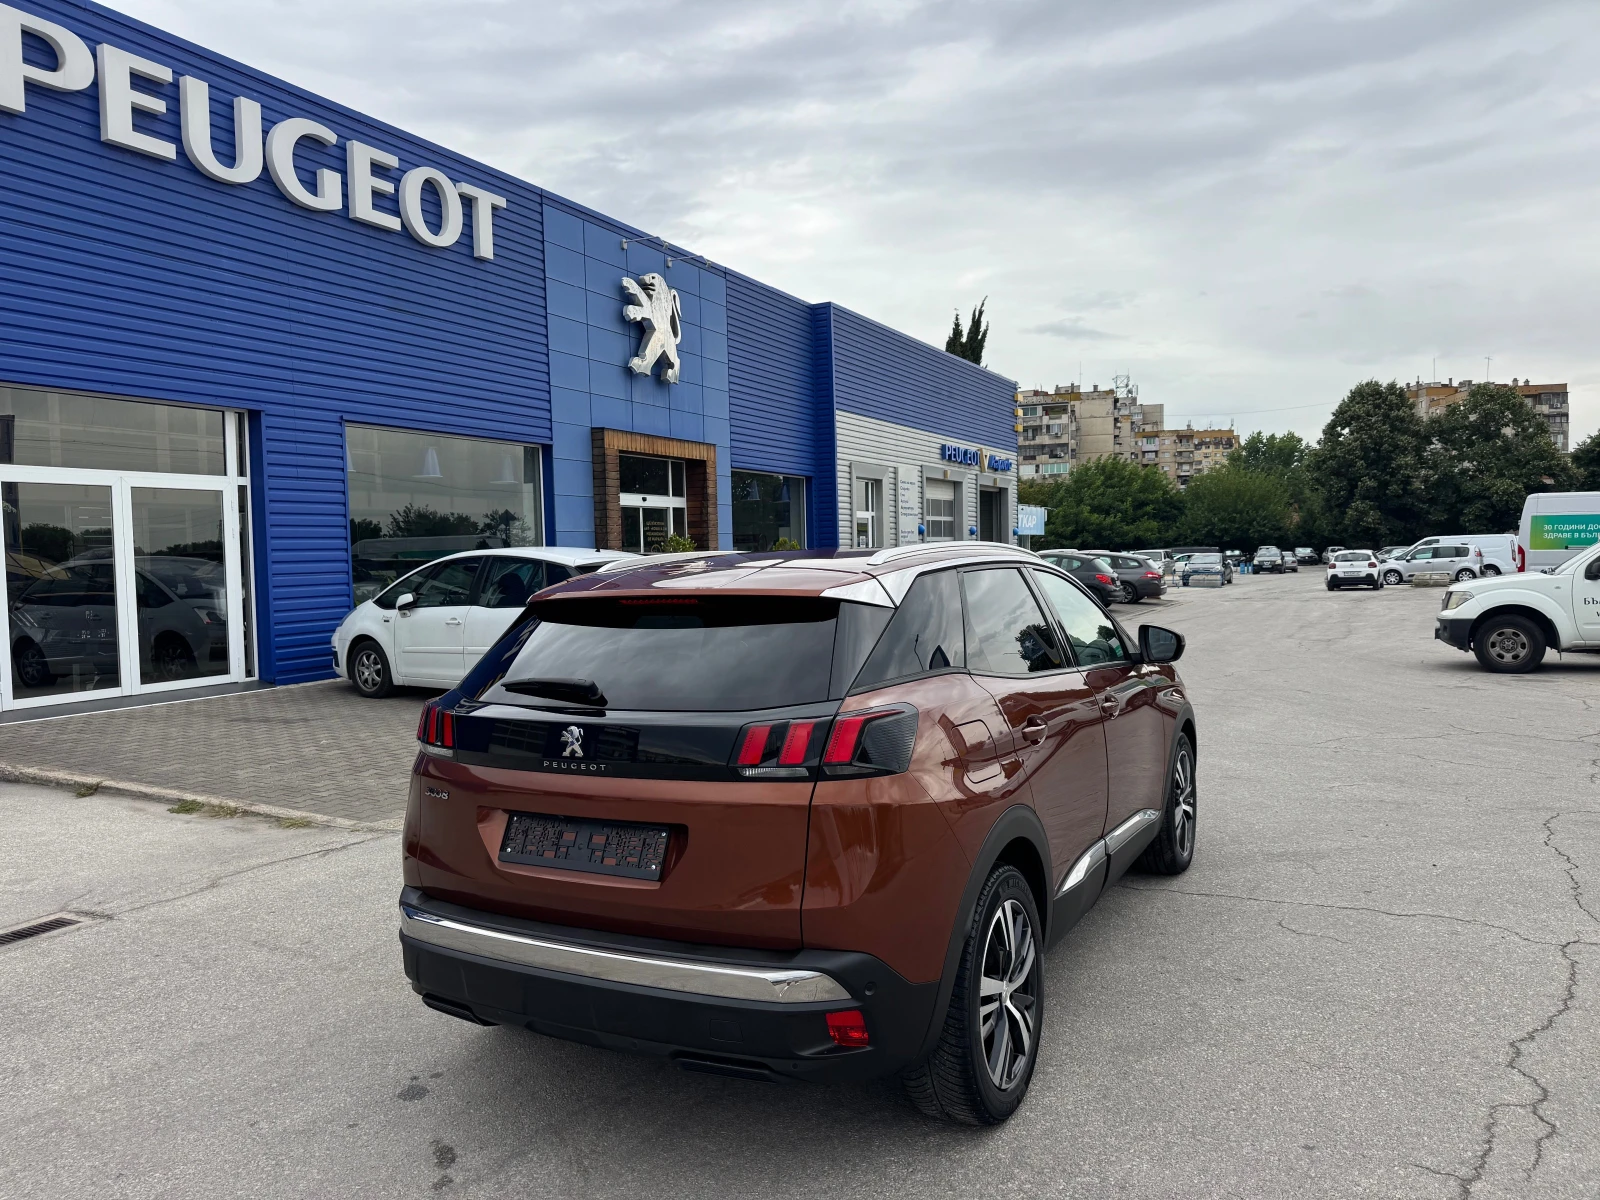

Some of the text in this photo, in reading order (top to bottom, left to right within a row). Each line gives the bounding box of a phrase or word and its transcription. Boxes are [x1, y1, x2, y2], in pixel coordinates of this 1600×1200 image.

[0, 4, 507, 260] PEUGEOT
[943, 444, 980, 466] PEUGEOT
[543, 760, 607, 771] PEUGEOT
